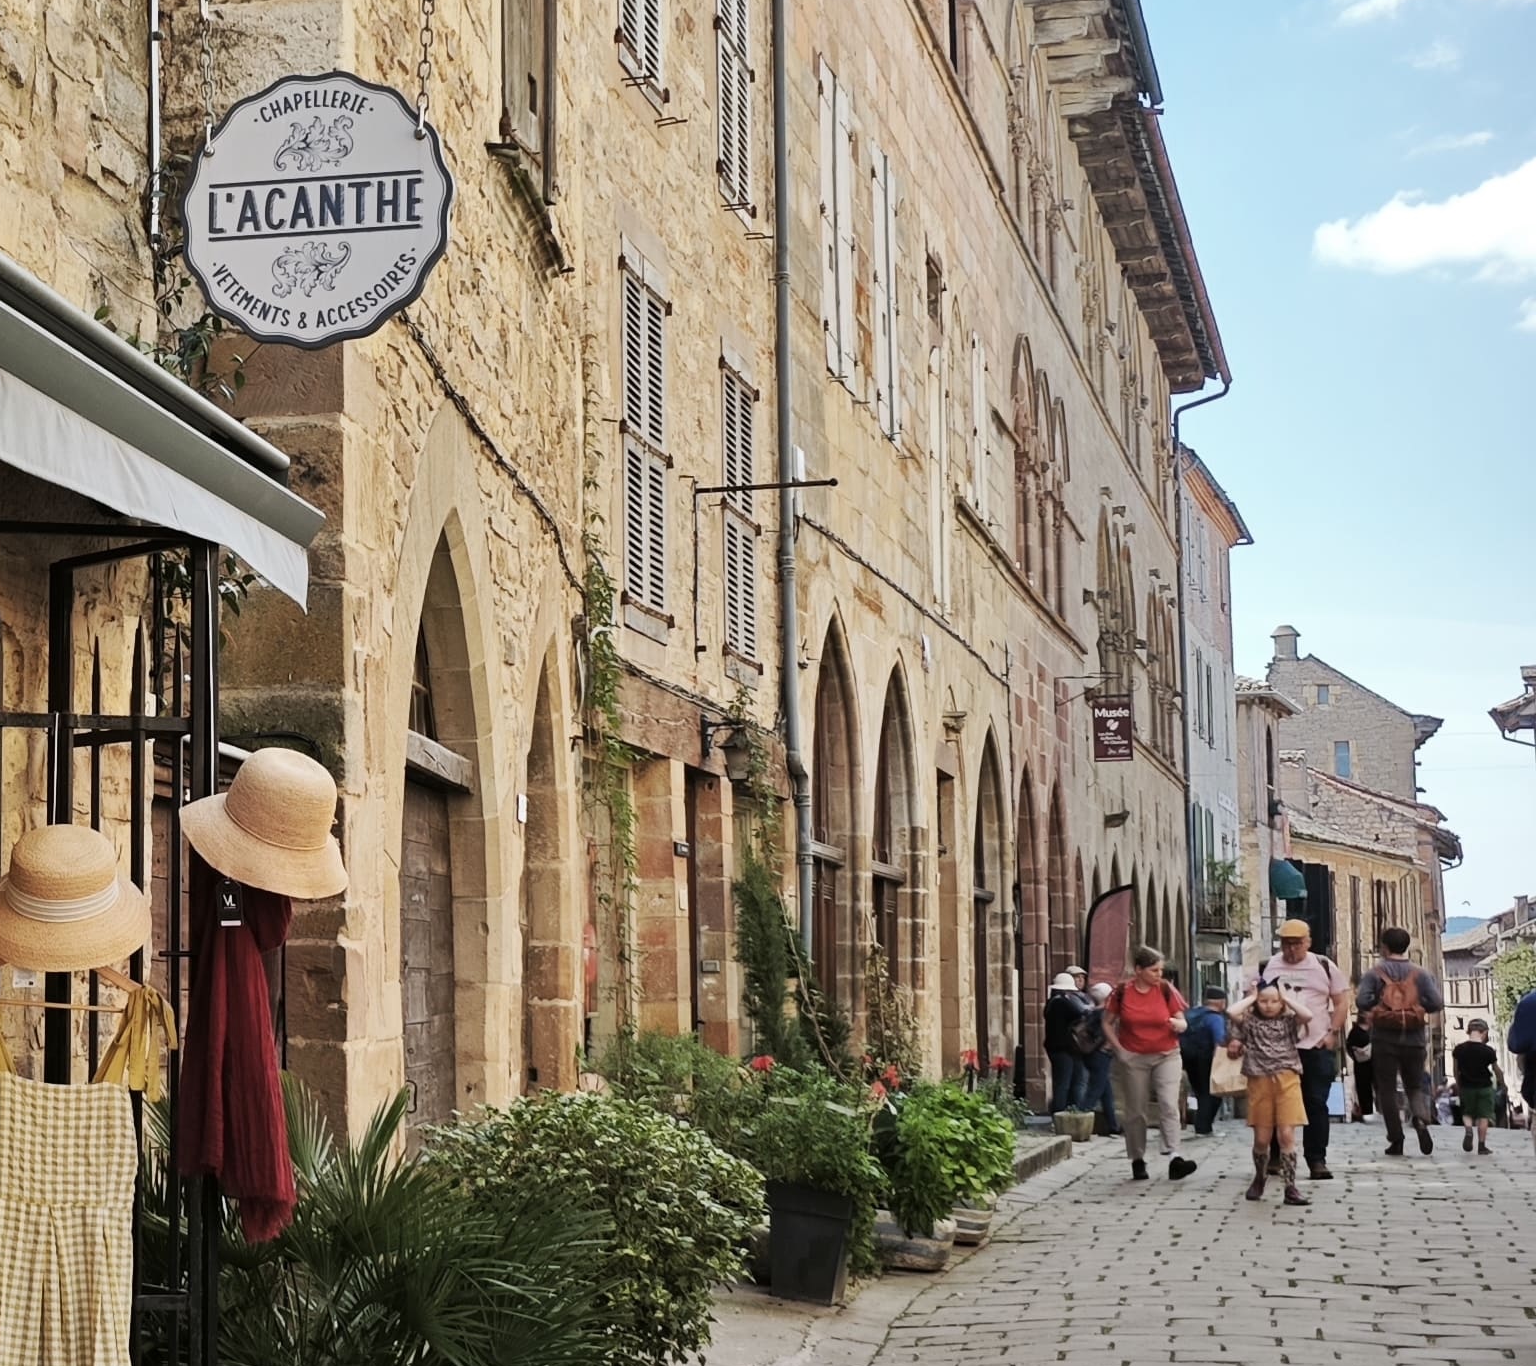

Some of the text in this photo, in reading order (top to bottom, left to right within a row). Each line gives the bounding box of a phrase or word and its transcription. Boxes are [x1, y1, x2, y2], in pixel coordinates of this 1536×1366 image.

[260, 89, 369, 123] CHAPELLERIE
[208, 177, 423, 235] L'ACANTHE
[297, 312, 307, 329] &
[315, 252, 418, 329] ACCESSOIRES
[1094, 706, 1130, 718] Musée
